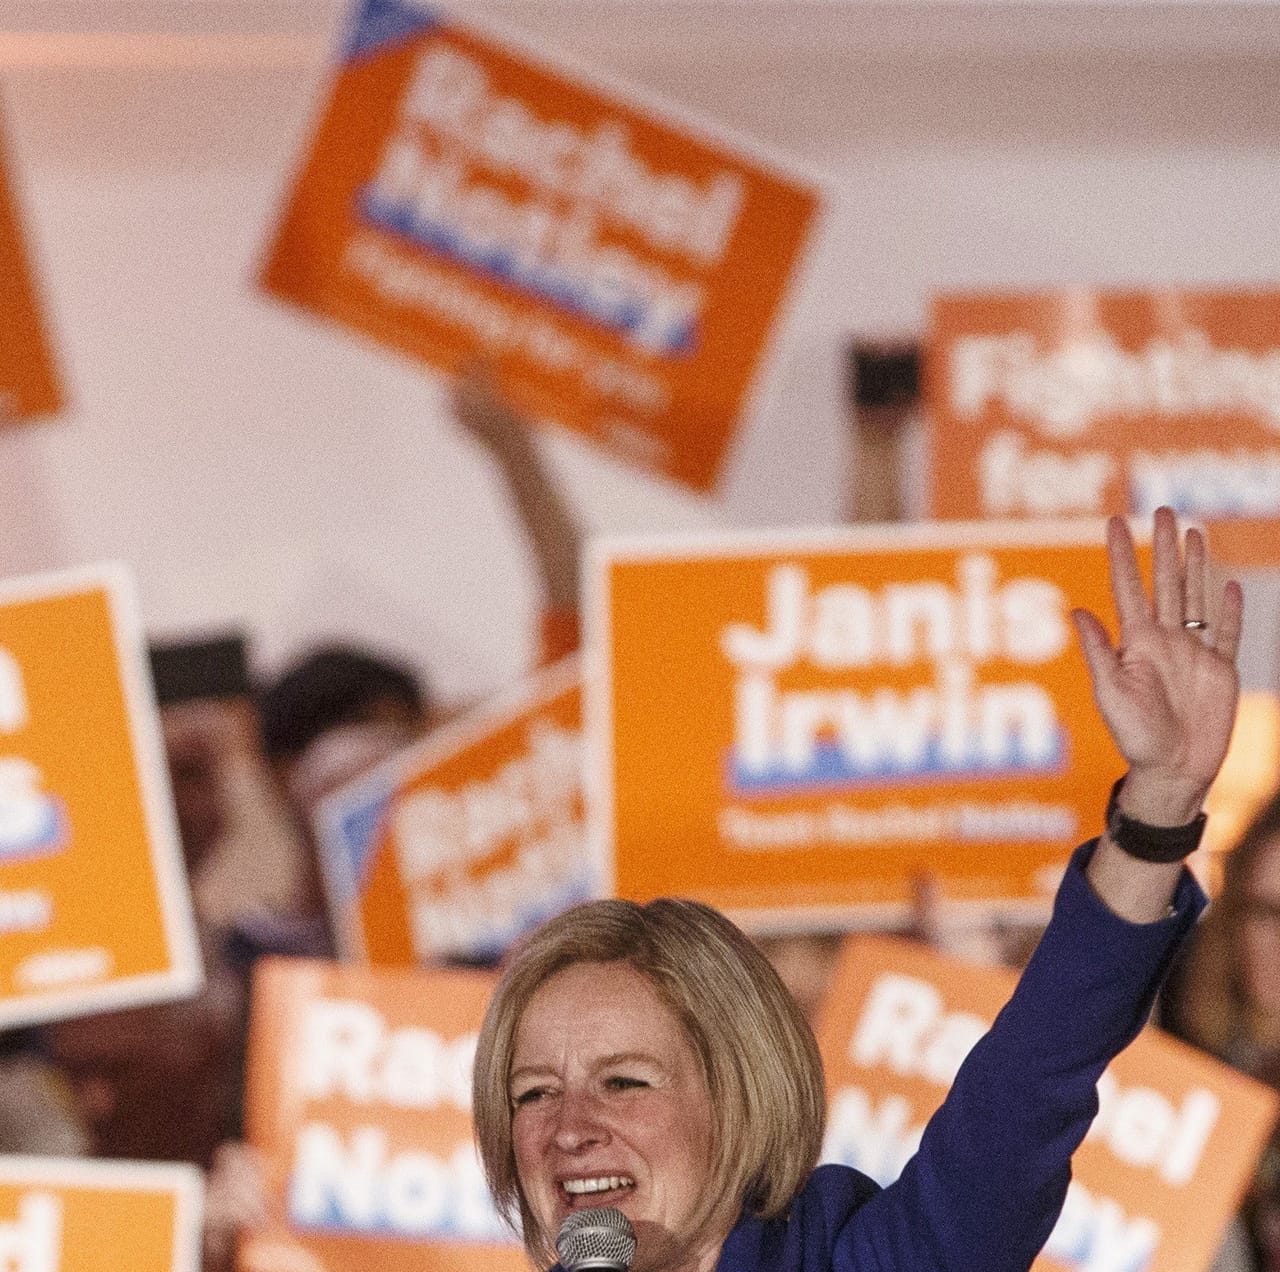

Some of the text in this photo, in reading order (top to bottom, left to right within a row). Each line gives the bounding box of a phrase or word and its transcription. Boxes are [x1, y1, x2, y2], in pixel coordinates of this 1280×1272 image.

[402, 44, 748, 266] Rachel
[376, 131, 710, 356] Notley
[978, 430, 1117, 514] for
[723, 553, 1070, 670] Janis
[734, 662, 1058, 776] Irwin
